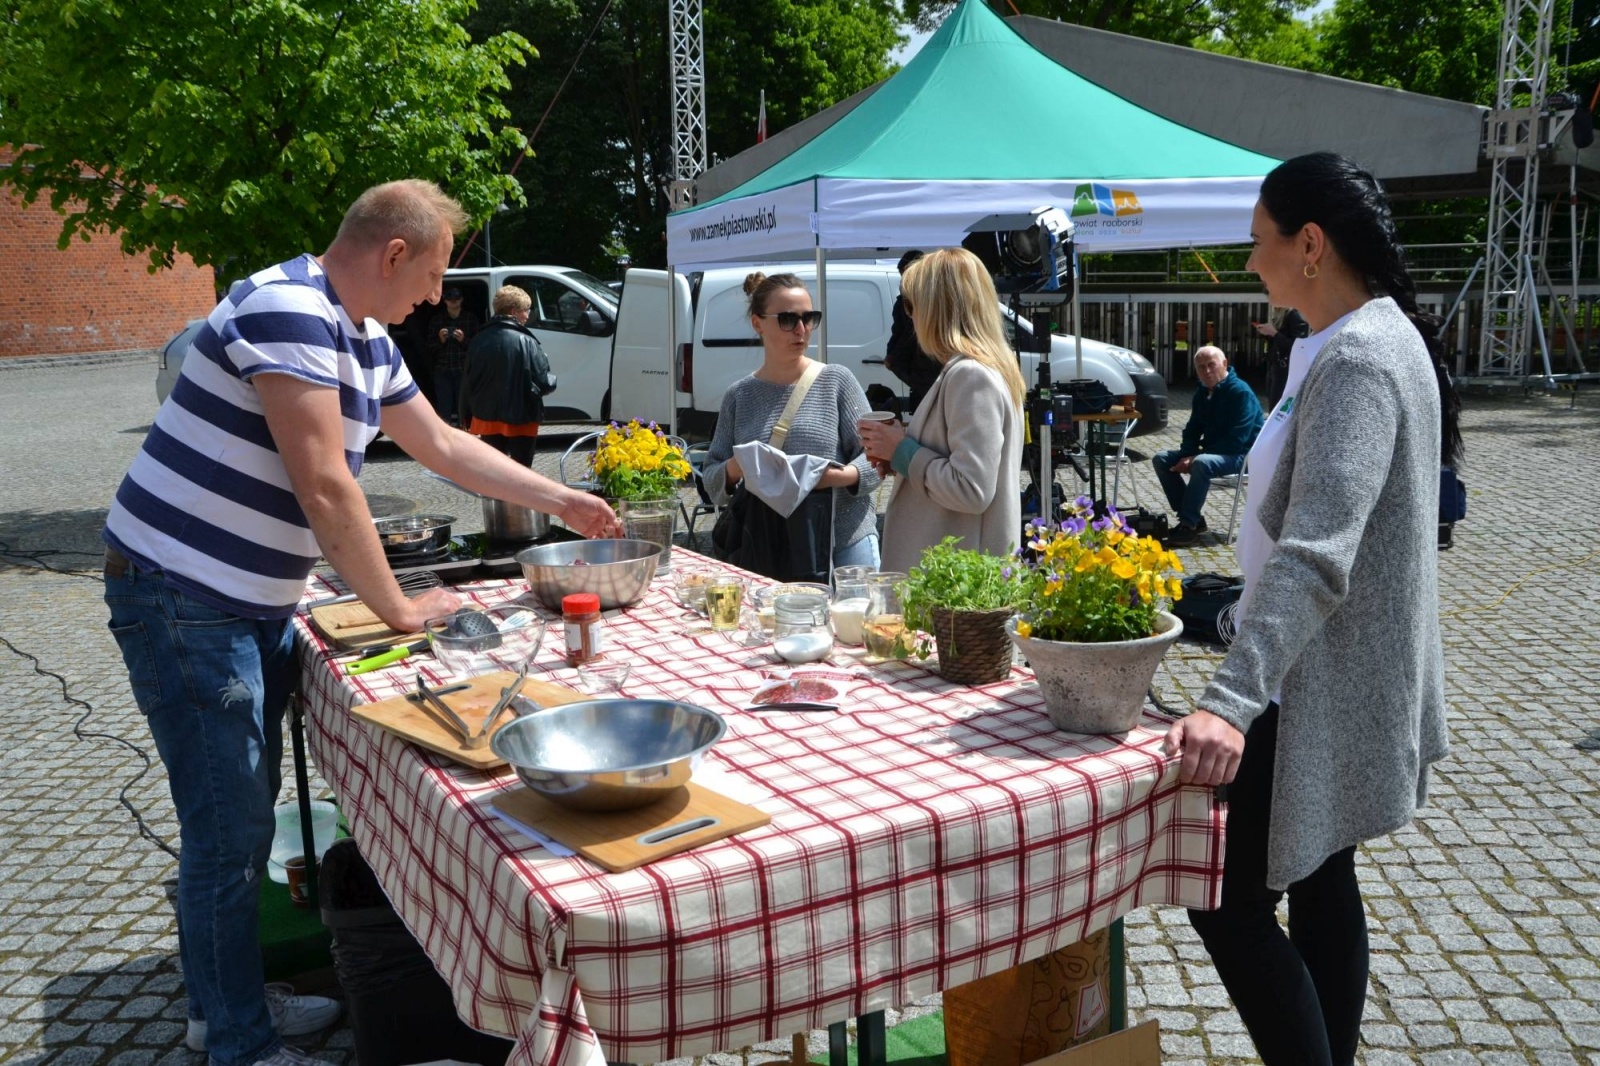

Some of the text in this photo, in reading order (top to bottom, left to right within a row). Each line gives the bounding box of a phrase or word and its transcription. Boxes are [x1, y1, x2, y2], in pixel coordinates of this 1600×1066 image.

[689, 205, 777, 242] www.zamekpiastowski.pl
[1074, 217, 1143, 228] owiat raciborski
